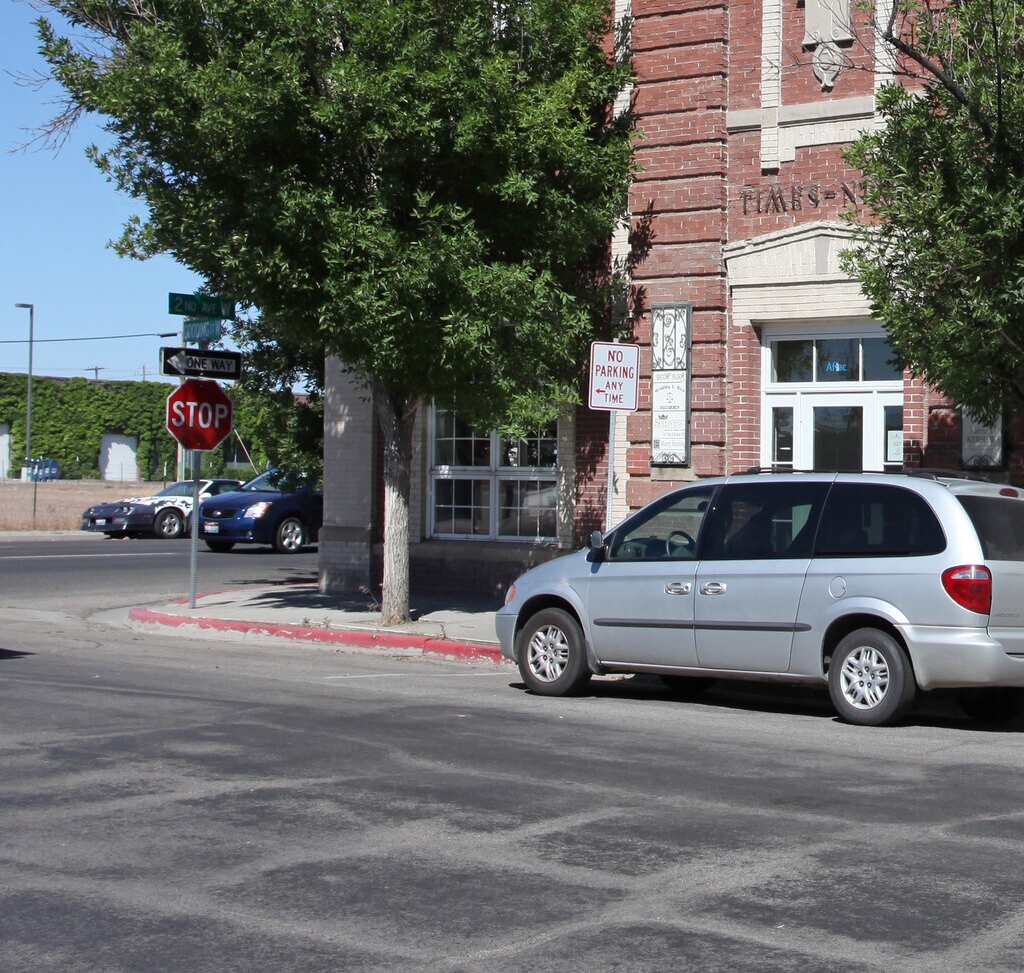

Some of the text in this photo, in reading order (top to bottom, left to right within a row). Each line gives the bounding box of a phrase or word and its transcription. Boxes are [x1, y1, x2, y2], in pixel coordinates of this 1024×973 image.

[202, 302, 217, 315] AVE
[221, 299, 231, 318] W
[607, 350, 624, 363] NO
[187, 357, 234, 371] ONE WAY
[595, 365, 634, 379] PARKING
[605, 381, 624, 391] ANY
[604, 393, 624, 404] TIME
[171, 400, 229, 429] STOP
